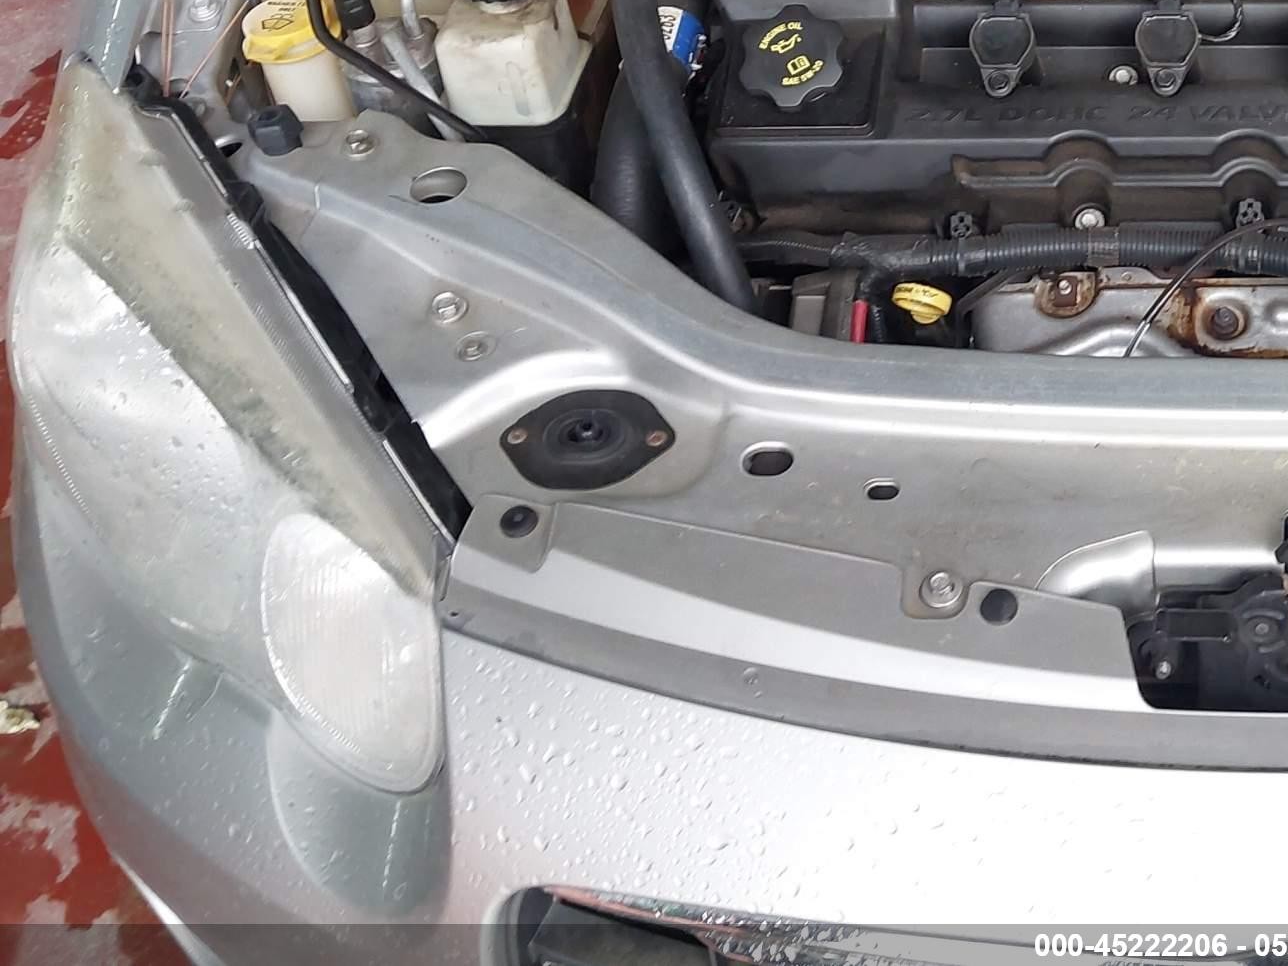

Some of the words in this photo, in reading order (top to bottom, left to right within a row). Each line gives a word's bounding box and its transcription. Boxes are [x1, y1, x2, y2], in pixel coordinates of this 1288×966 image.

[759, 23, 788, 49] ENGINE
[787, 21, 803, 30] OIL
[782, 76, 801, 86] SAE
[904, 105, 983, 122] 2.7L
[996, 105, 1107, 122] DOHC
[1127, 105, 1177, 122] 24
